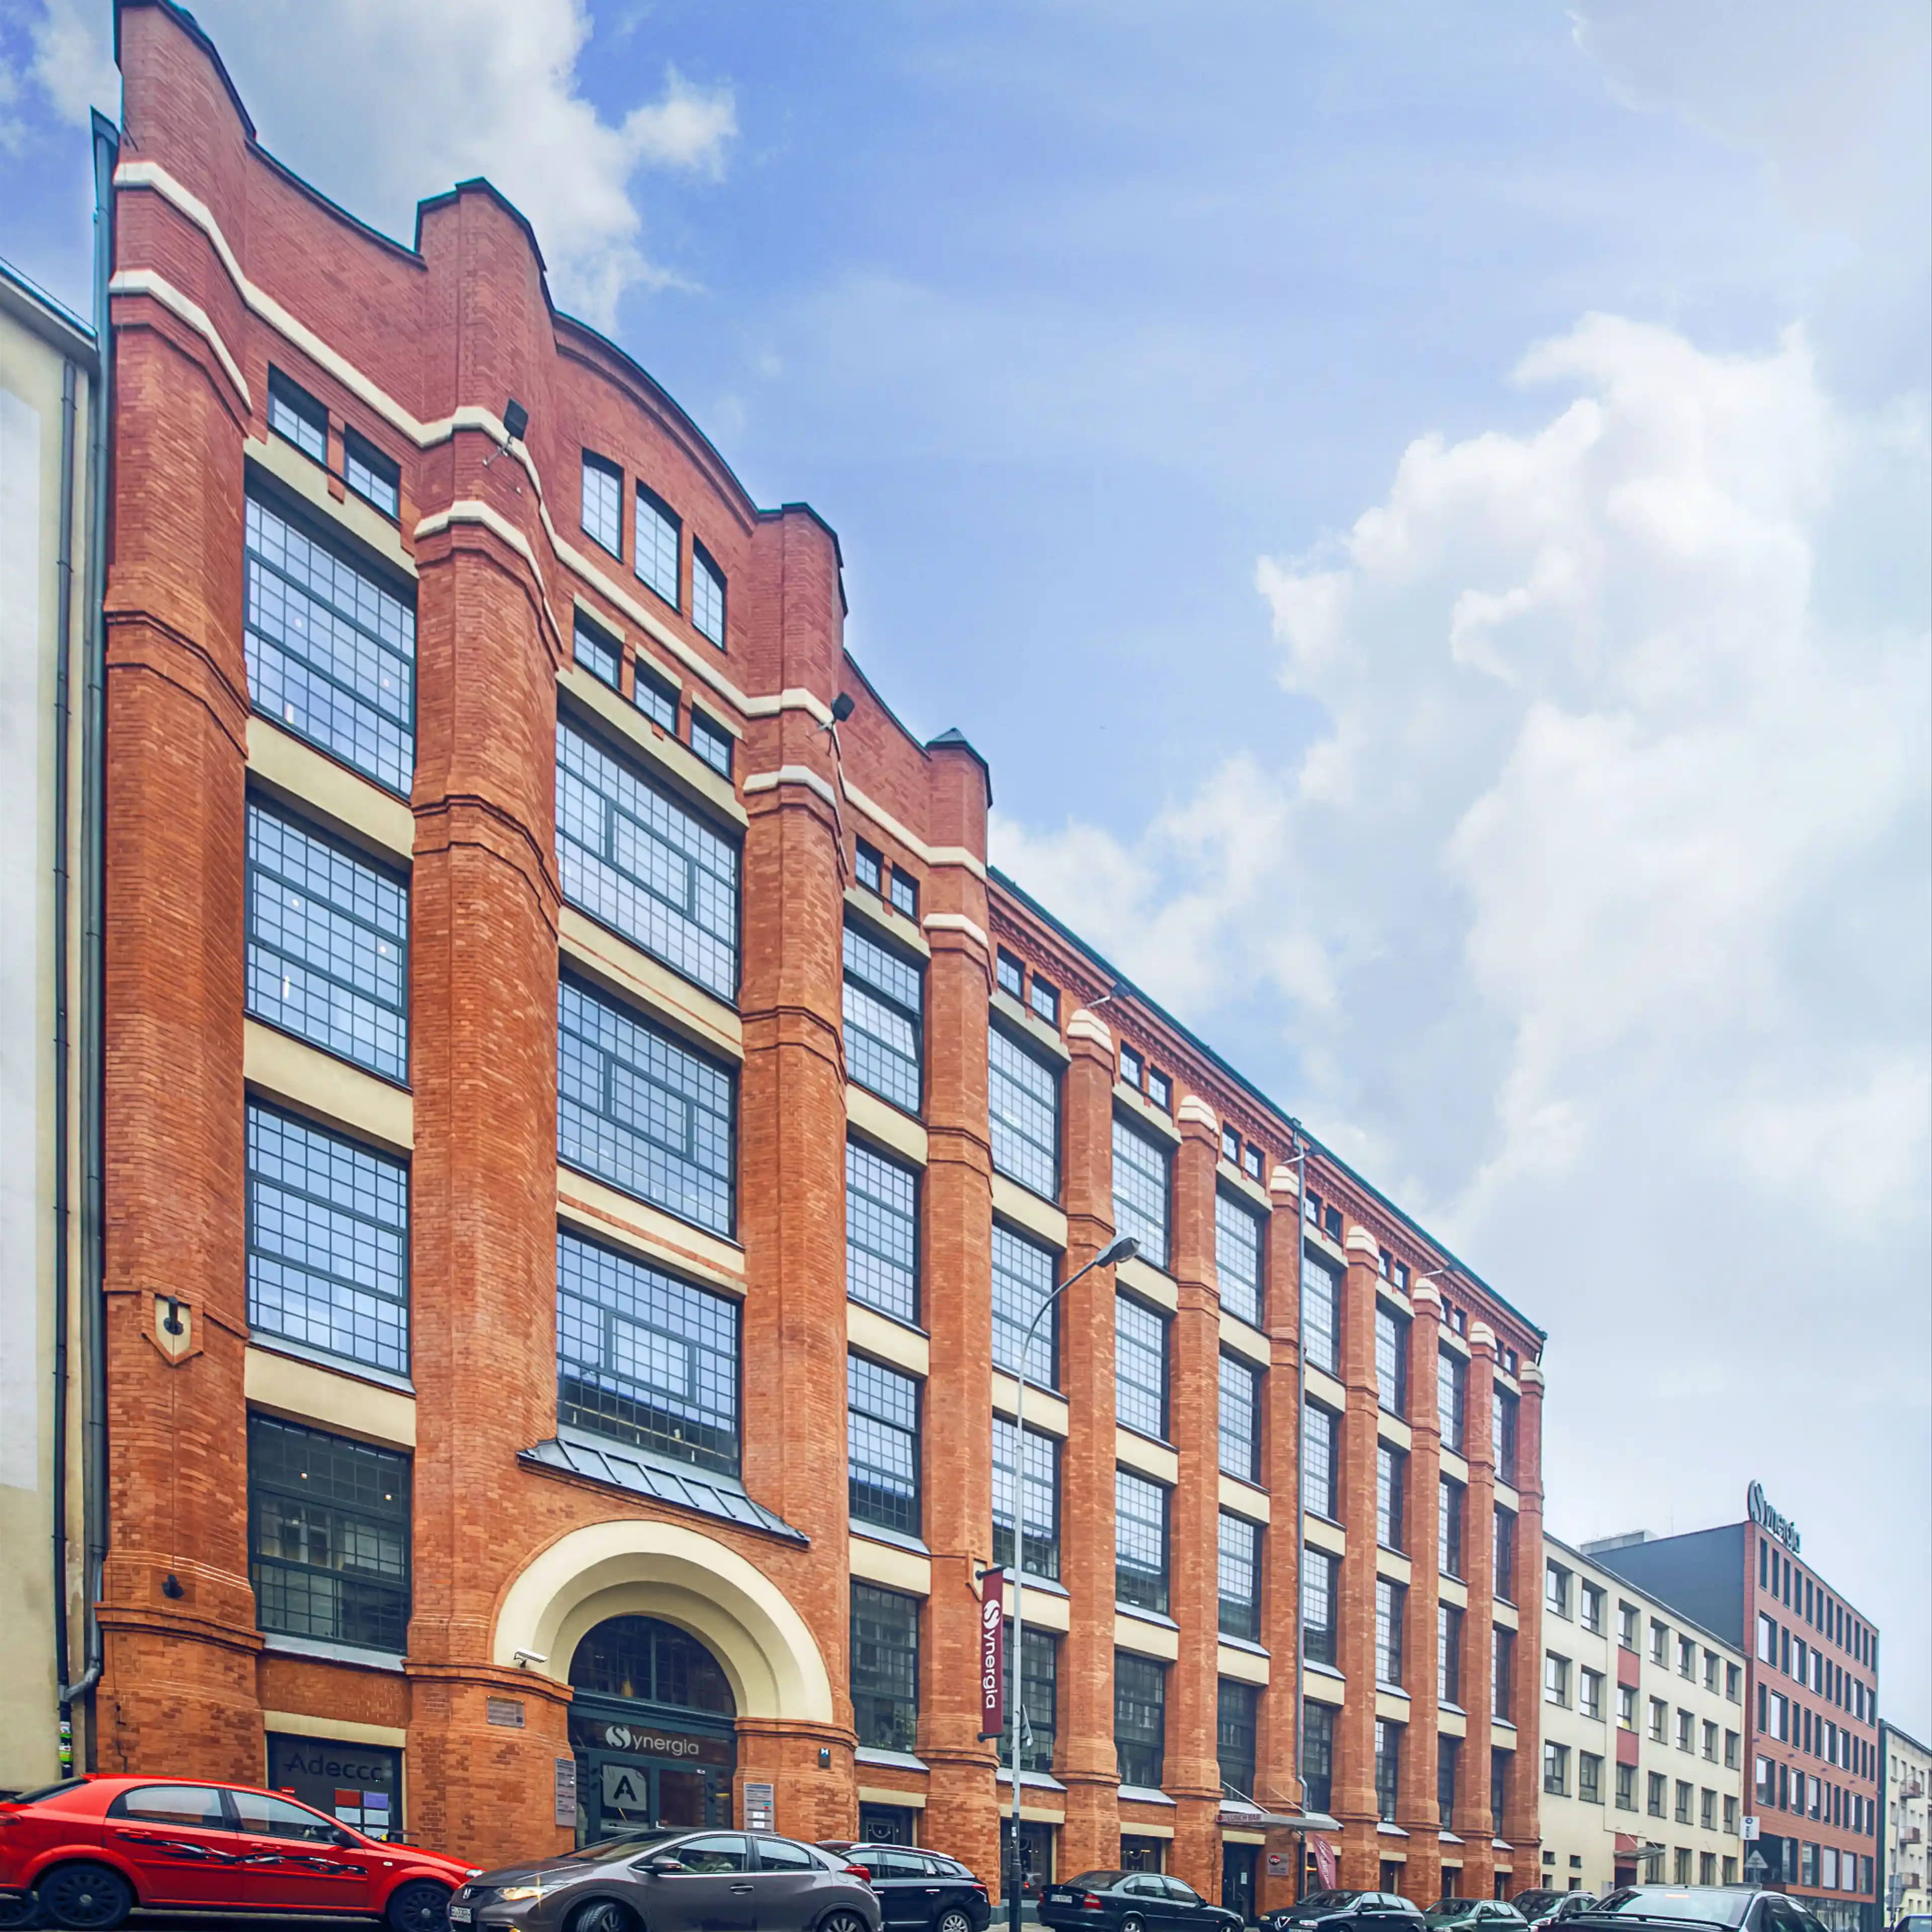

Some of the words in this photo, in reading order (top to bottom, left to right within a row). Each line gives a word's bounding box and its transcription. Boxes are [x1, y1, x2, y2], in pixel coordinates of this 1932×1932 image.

[1747, 1479, 1801, 1554] Synergia
[983, 1599, 1001, 1709] Synergia
[605, 1724, 699, 1756] Synergia
